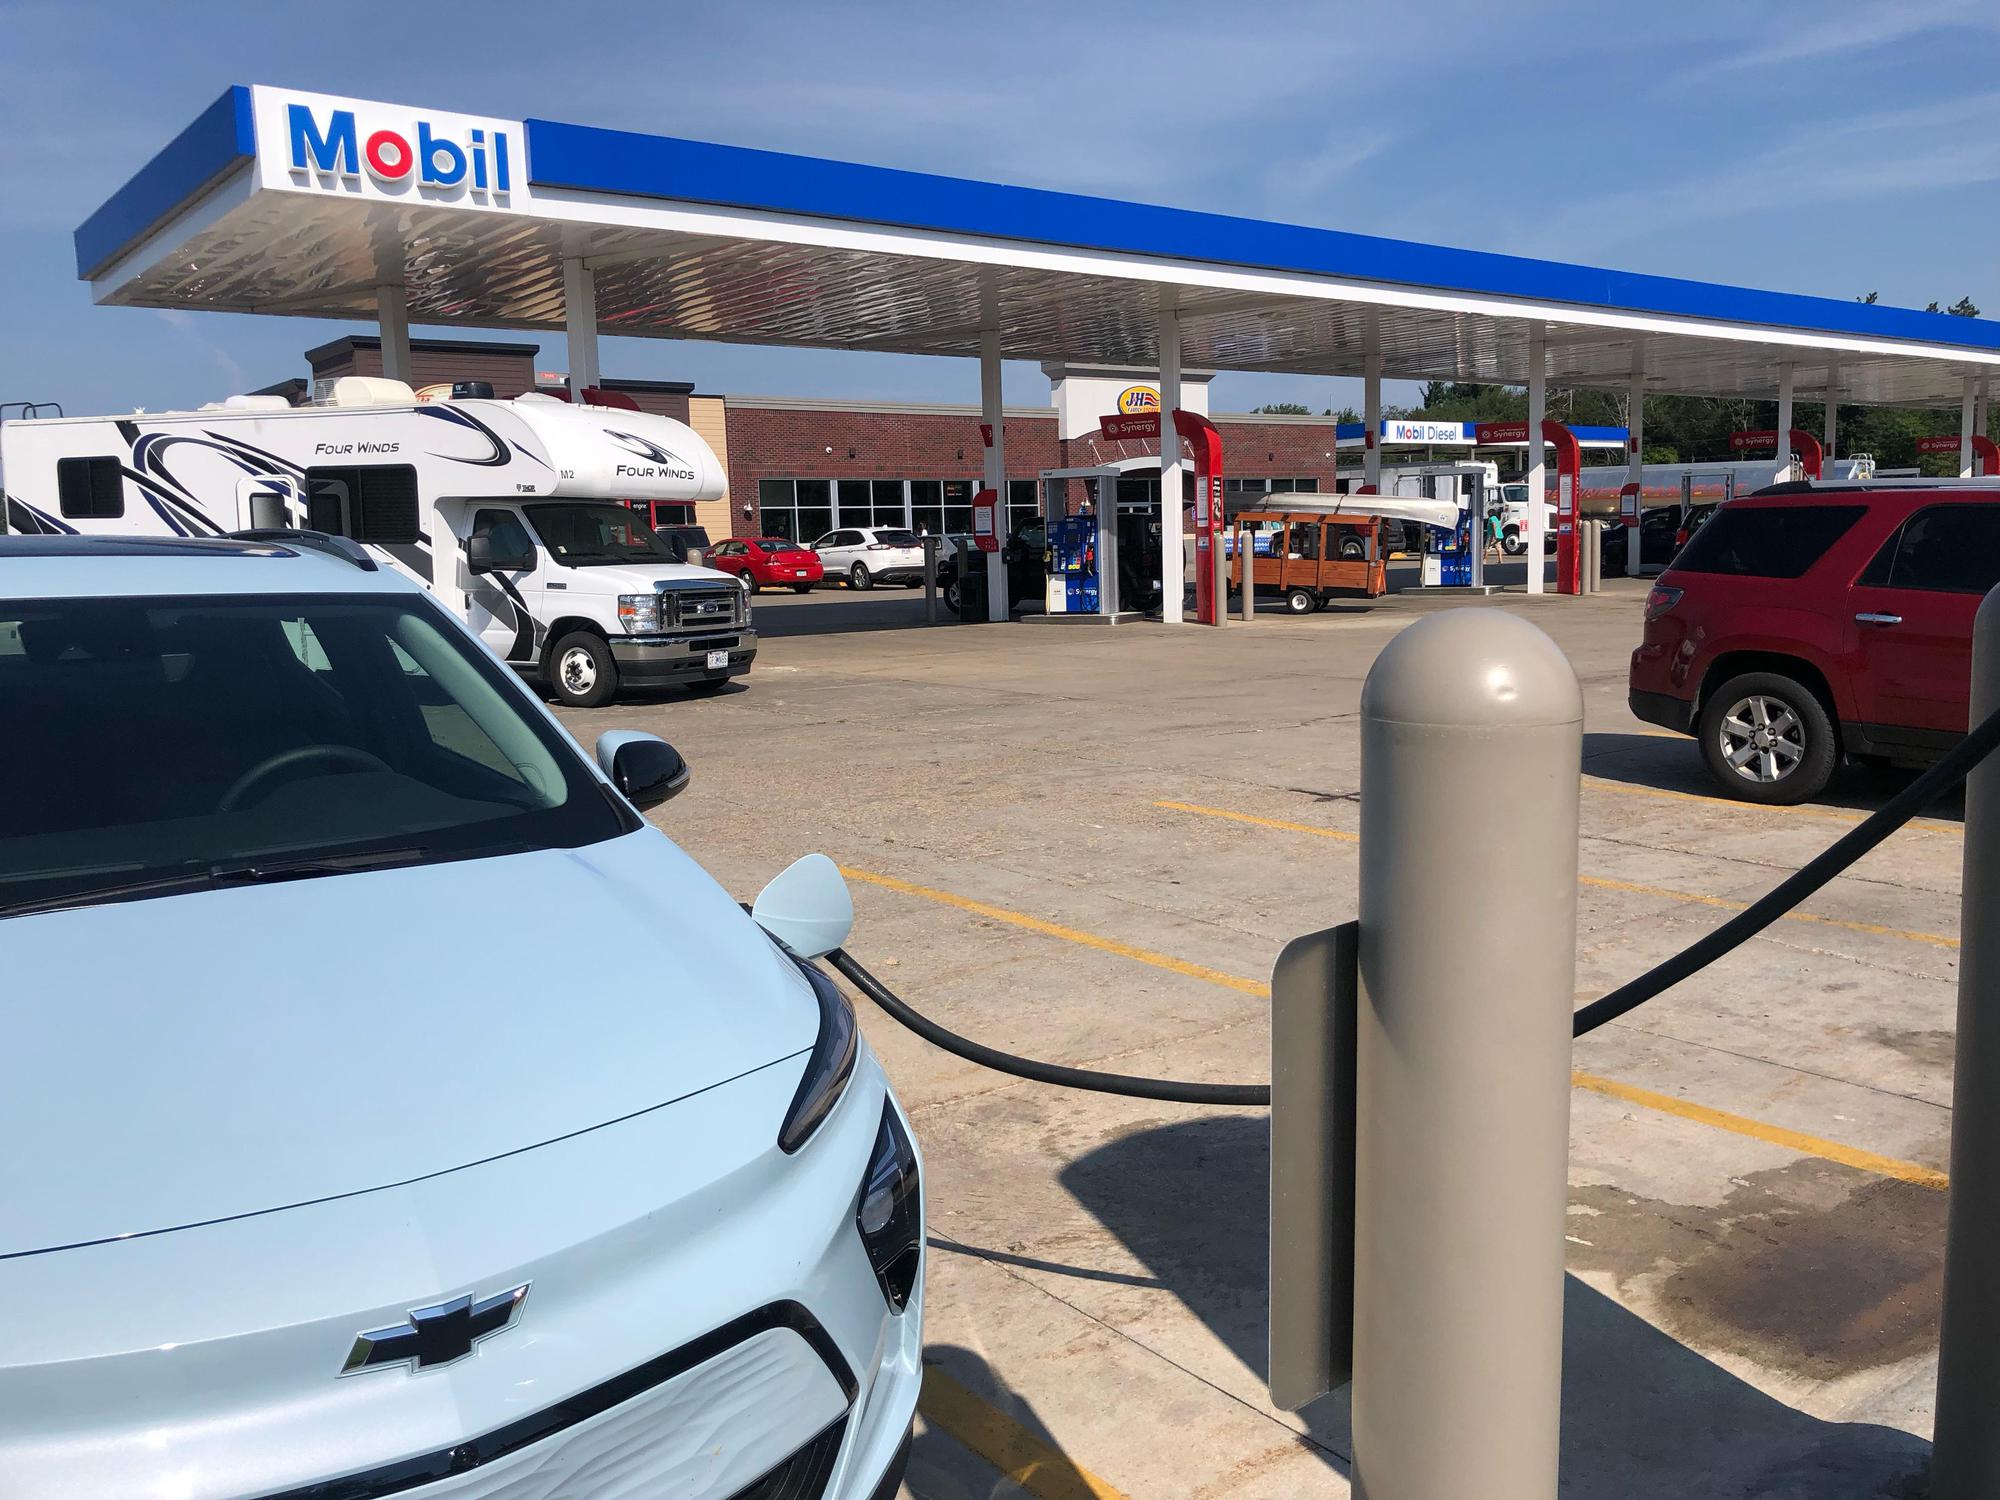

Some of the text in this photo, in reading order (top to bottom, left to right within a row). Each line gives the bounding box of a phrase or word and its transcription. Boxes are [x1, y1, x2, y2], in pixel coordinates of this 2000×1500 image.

[285, 103, 511, 193] Mobil
[1120, 422, 1156, 433] Synergy
[1396, 425, 1457, 441] Mobil Diesel
[1493, 430, 1526, 439] Synergy
[1745, 437, 1775, 445] Synergy
[560, 470, 575, 480] M2
